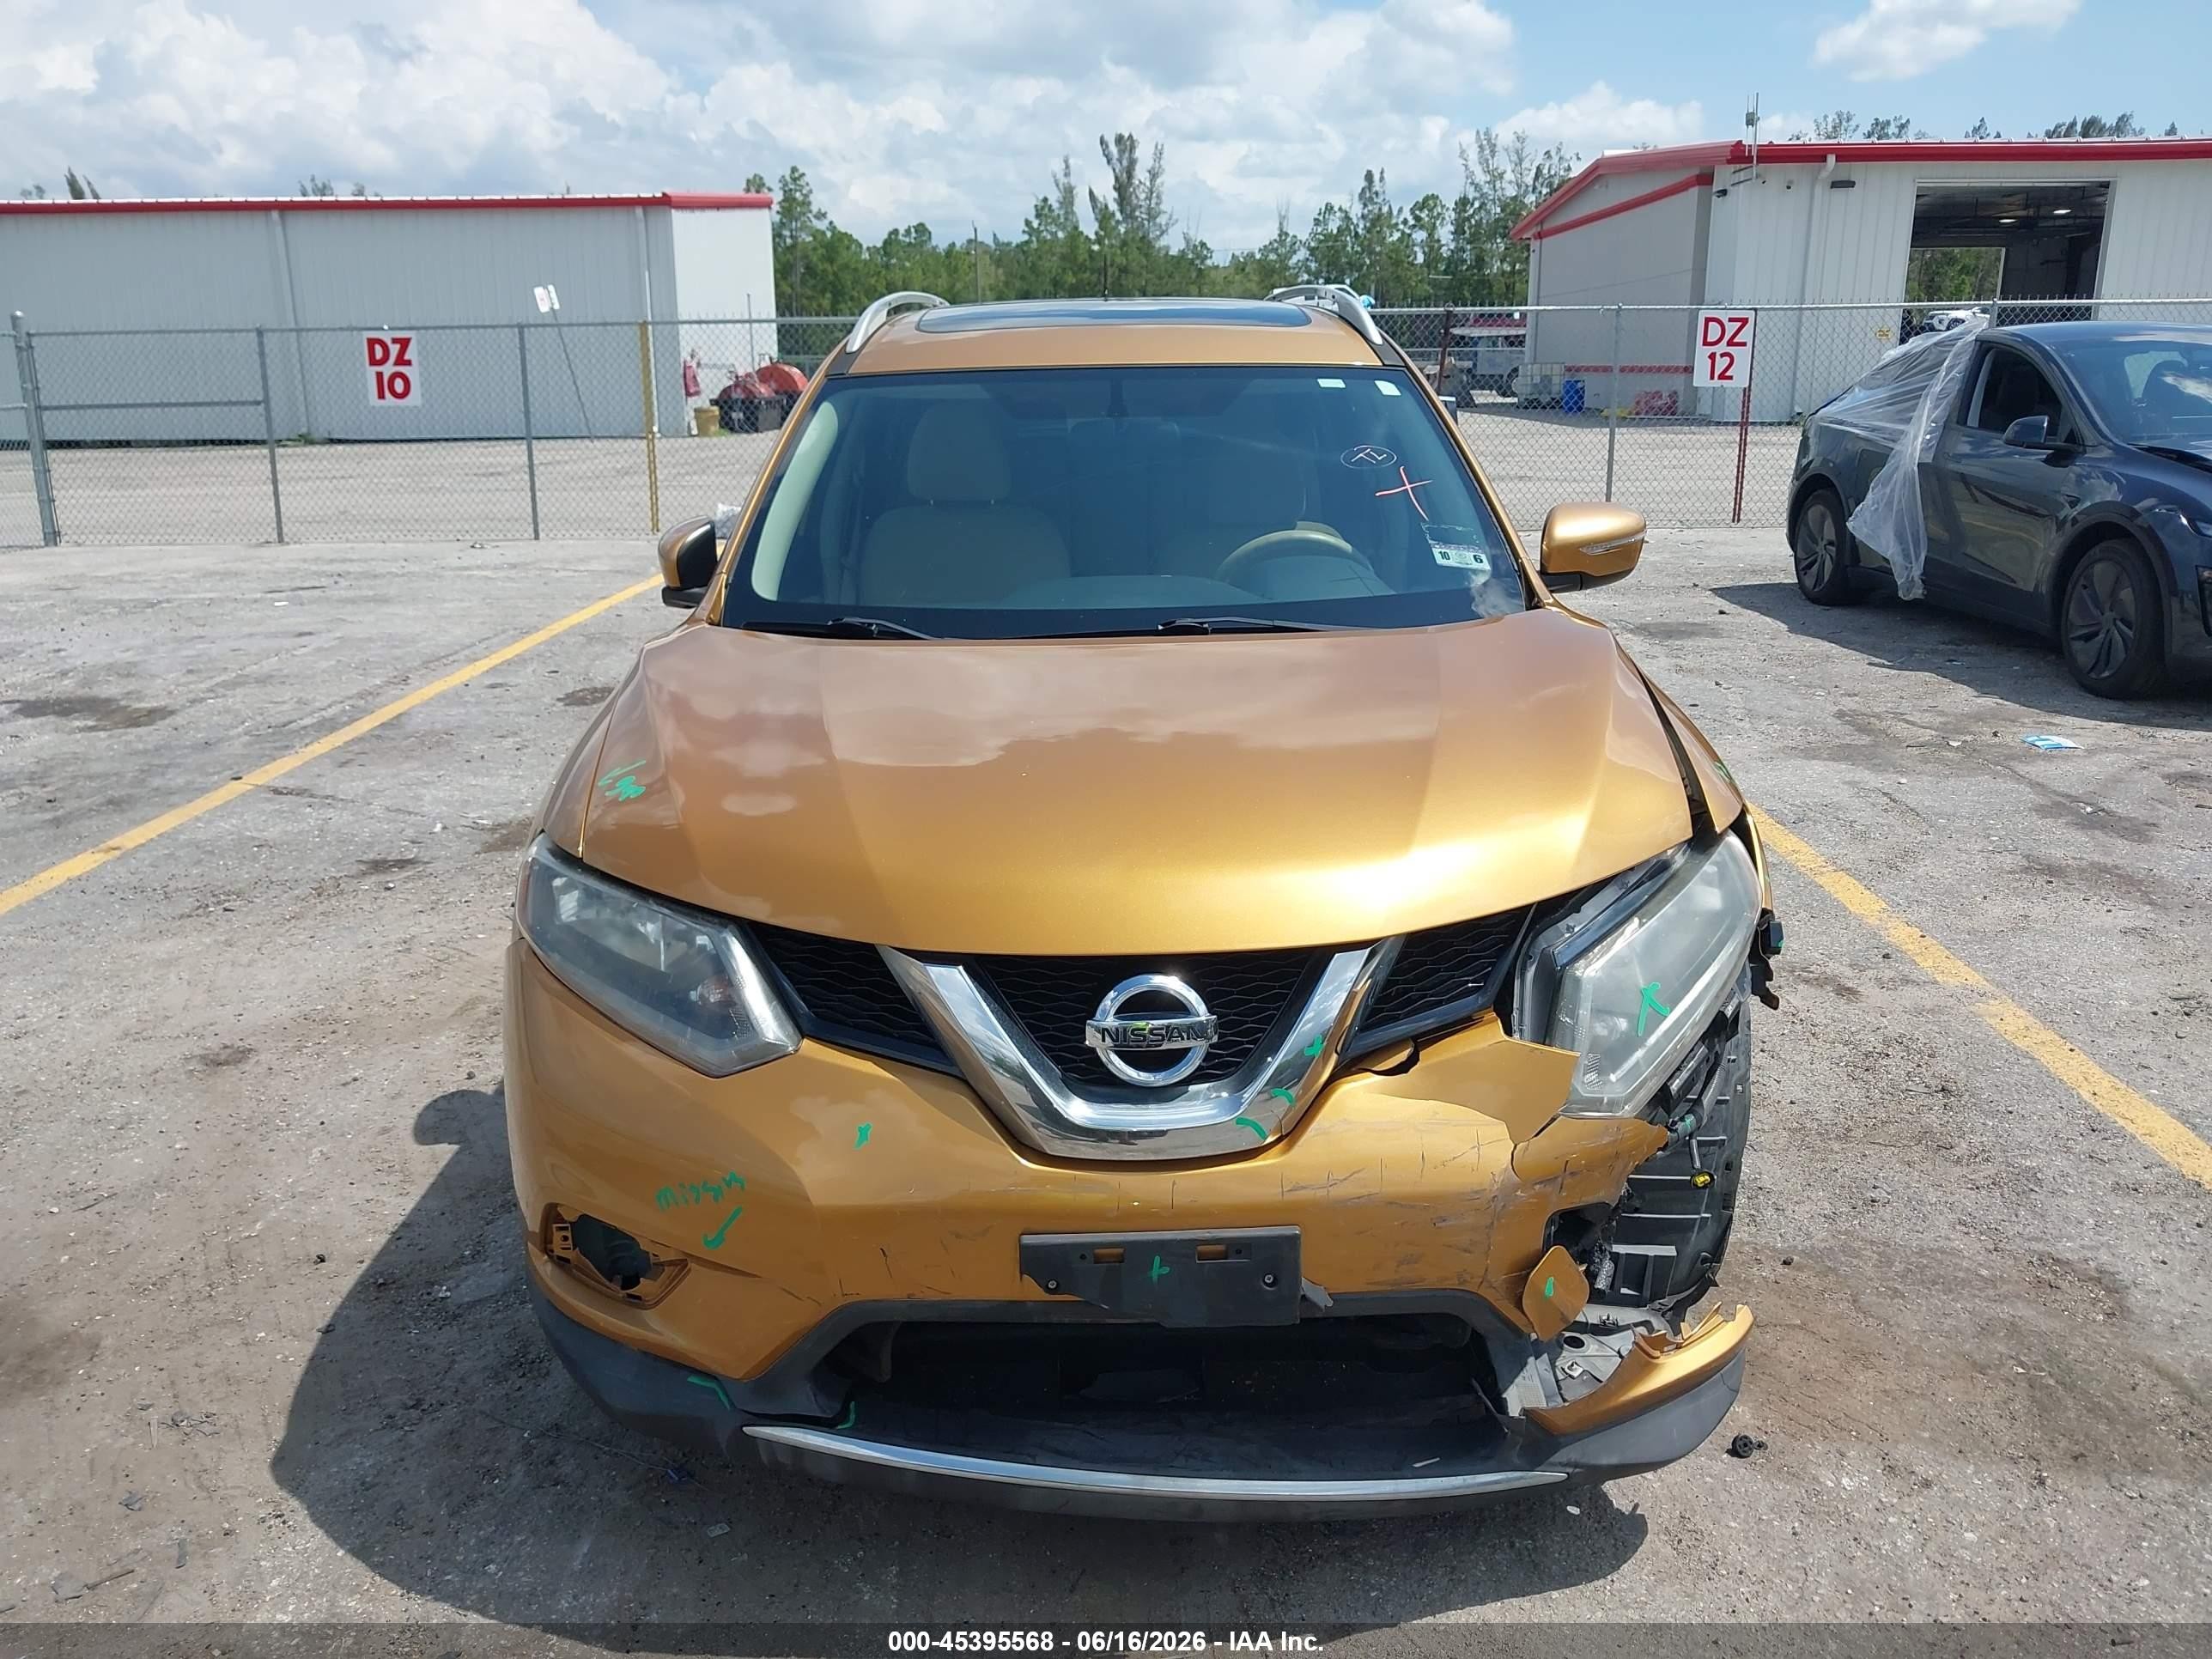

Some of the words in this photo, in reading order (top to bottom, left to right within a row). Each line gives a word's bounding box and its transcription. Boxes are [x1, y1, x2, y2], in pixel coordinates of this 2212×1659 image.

[1702, 316, 1749, 347] DZ
[366, 337, 412, 367] DZ
[1707, 351, 1735, 380] 12
[375, 371, 411, 400] 10
[1438, 550, 1451, 561] 10
[1473, 554, 1483, 563] 6
[1101, 1024, 1206, 1044] NISSAN
